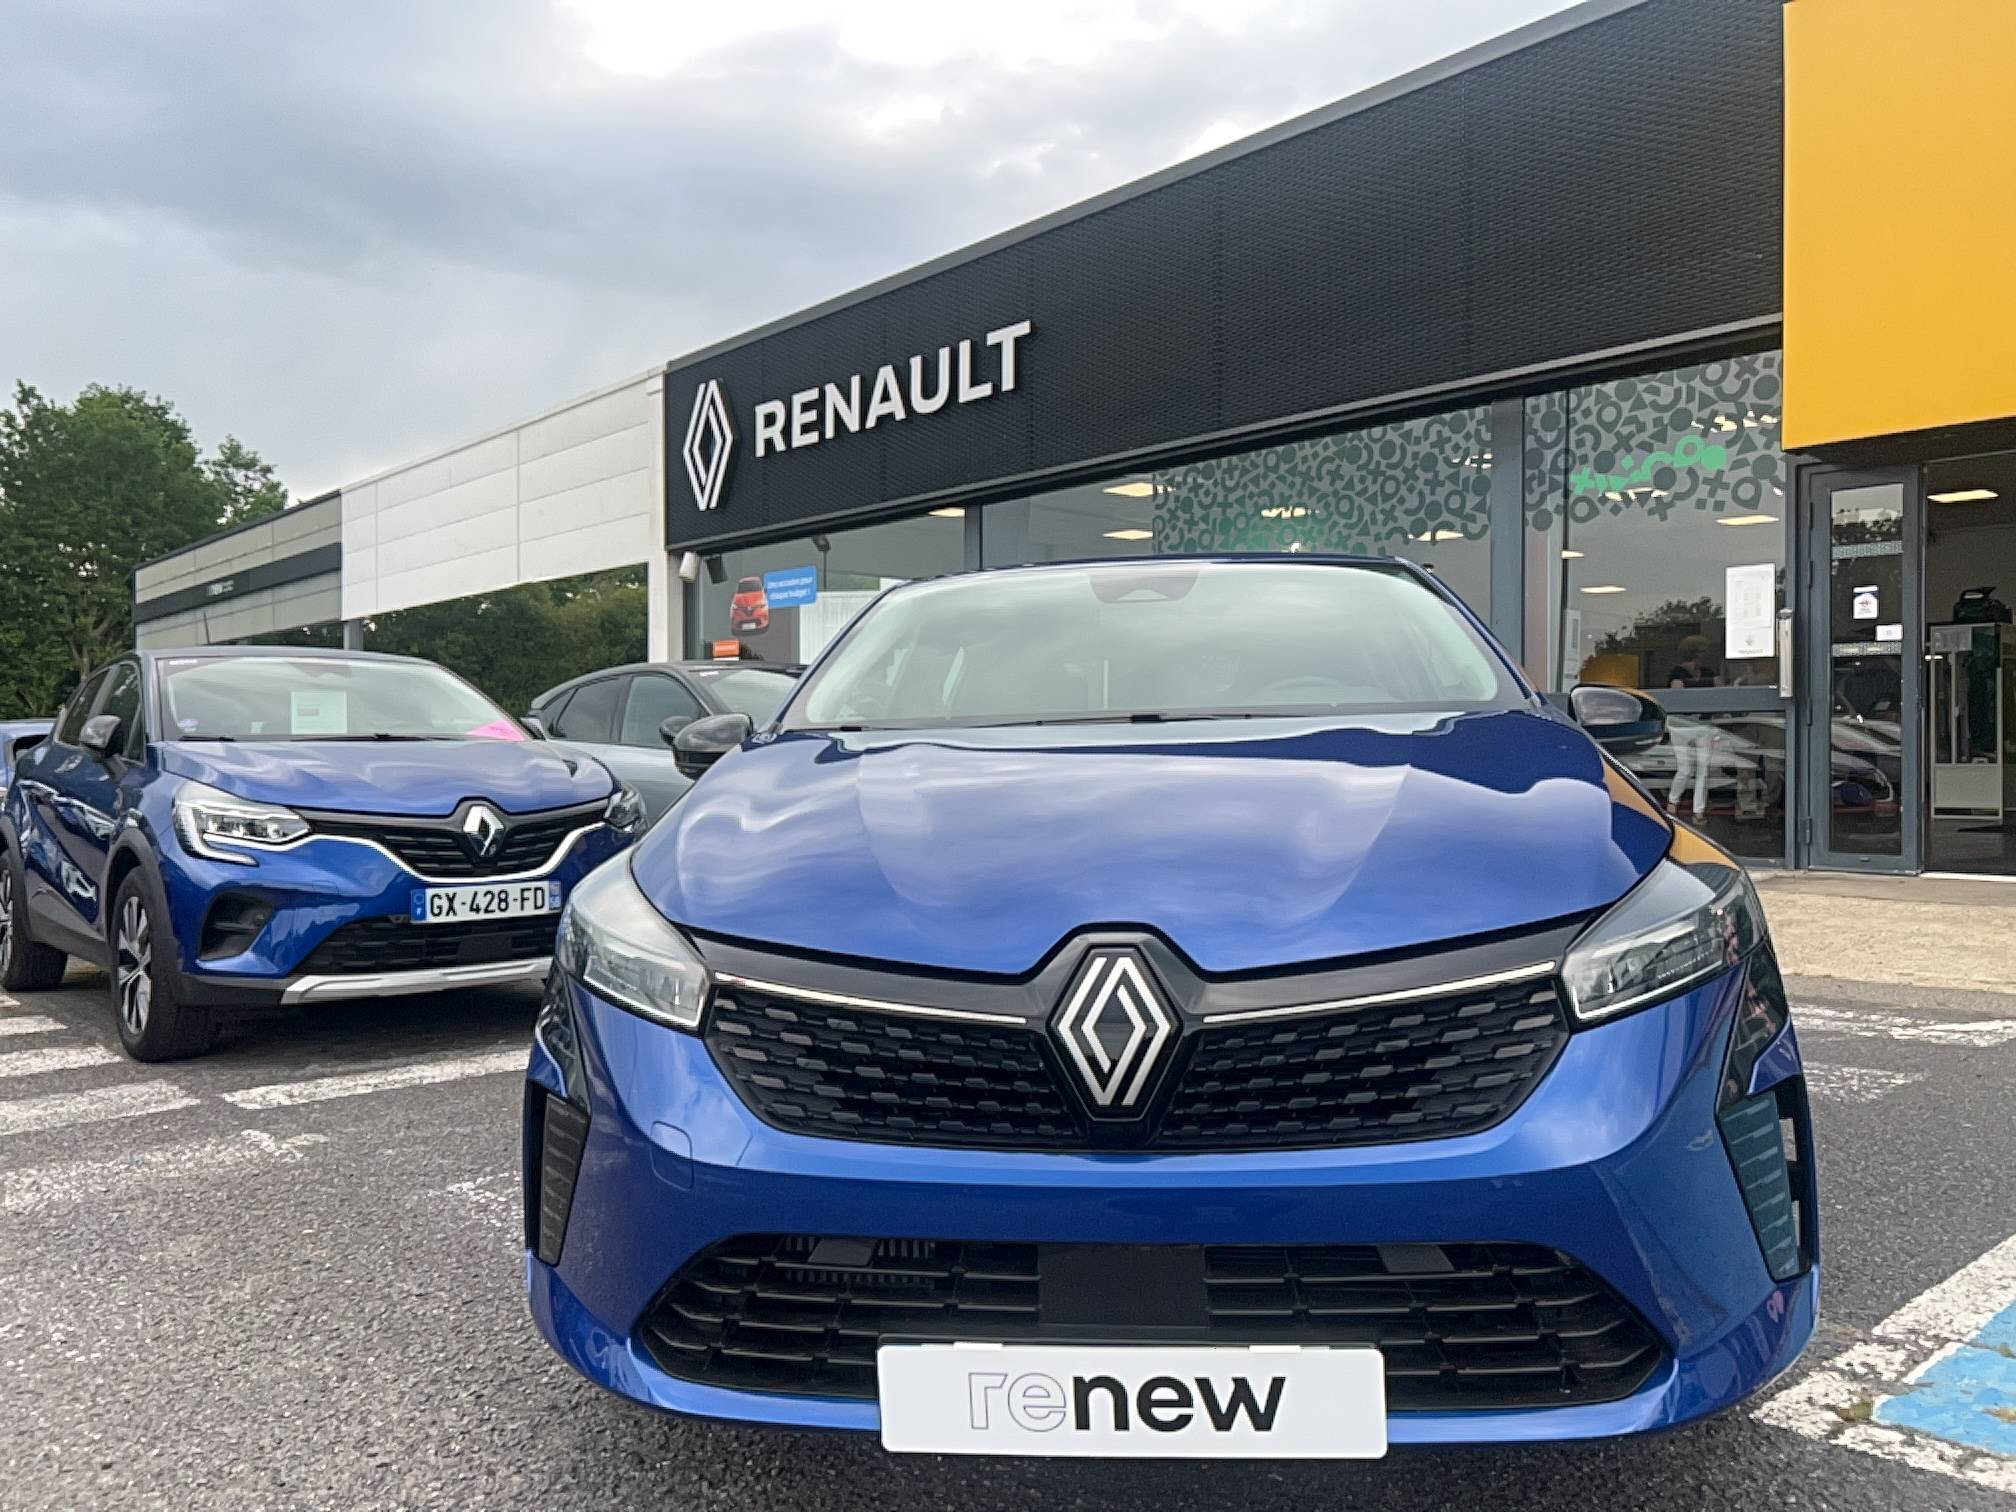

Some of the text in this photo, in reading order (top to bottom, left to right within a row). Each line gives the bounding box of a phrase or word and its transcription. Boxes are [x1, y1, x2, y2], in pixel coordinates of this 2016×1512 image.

[755, 319, 1031, 458] RENAULT
[430, 887, 545, 917] GX-428-FD
[968, 1372, 1286, 1432] renew
